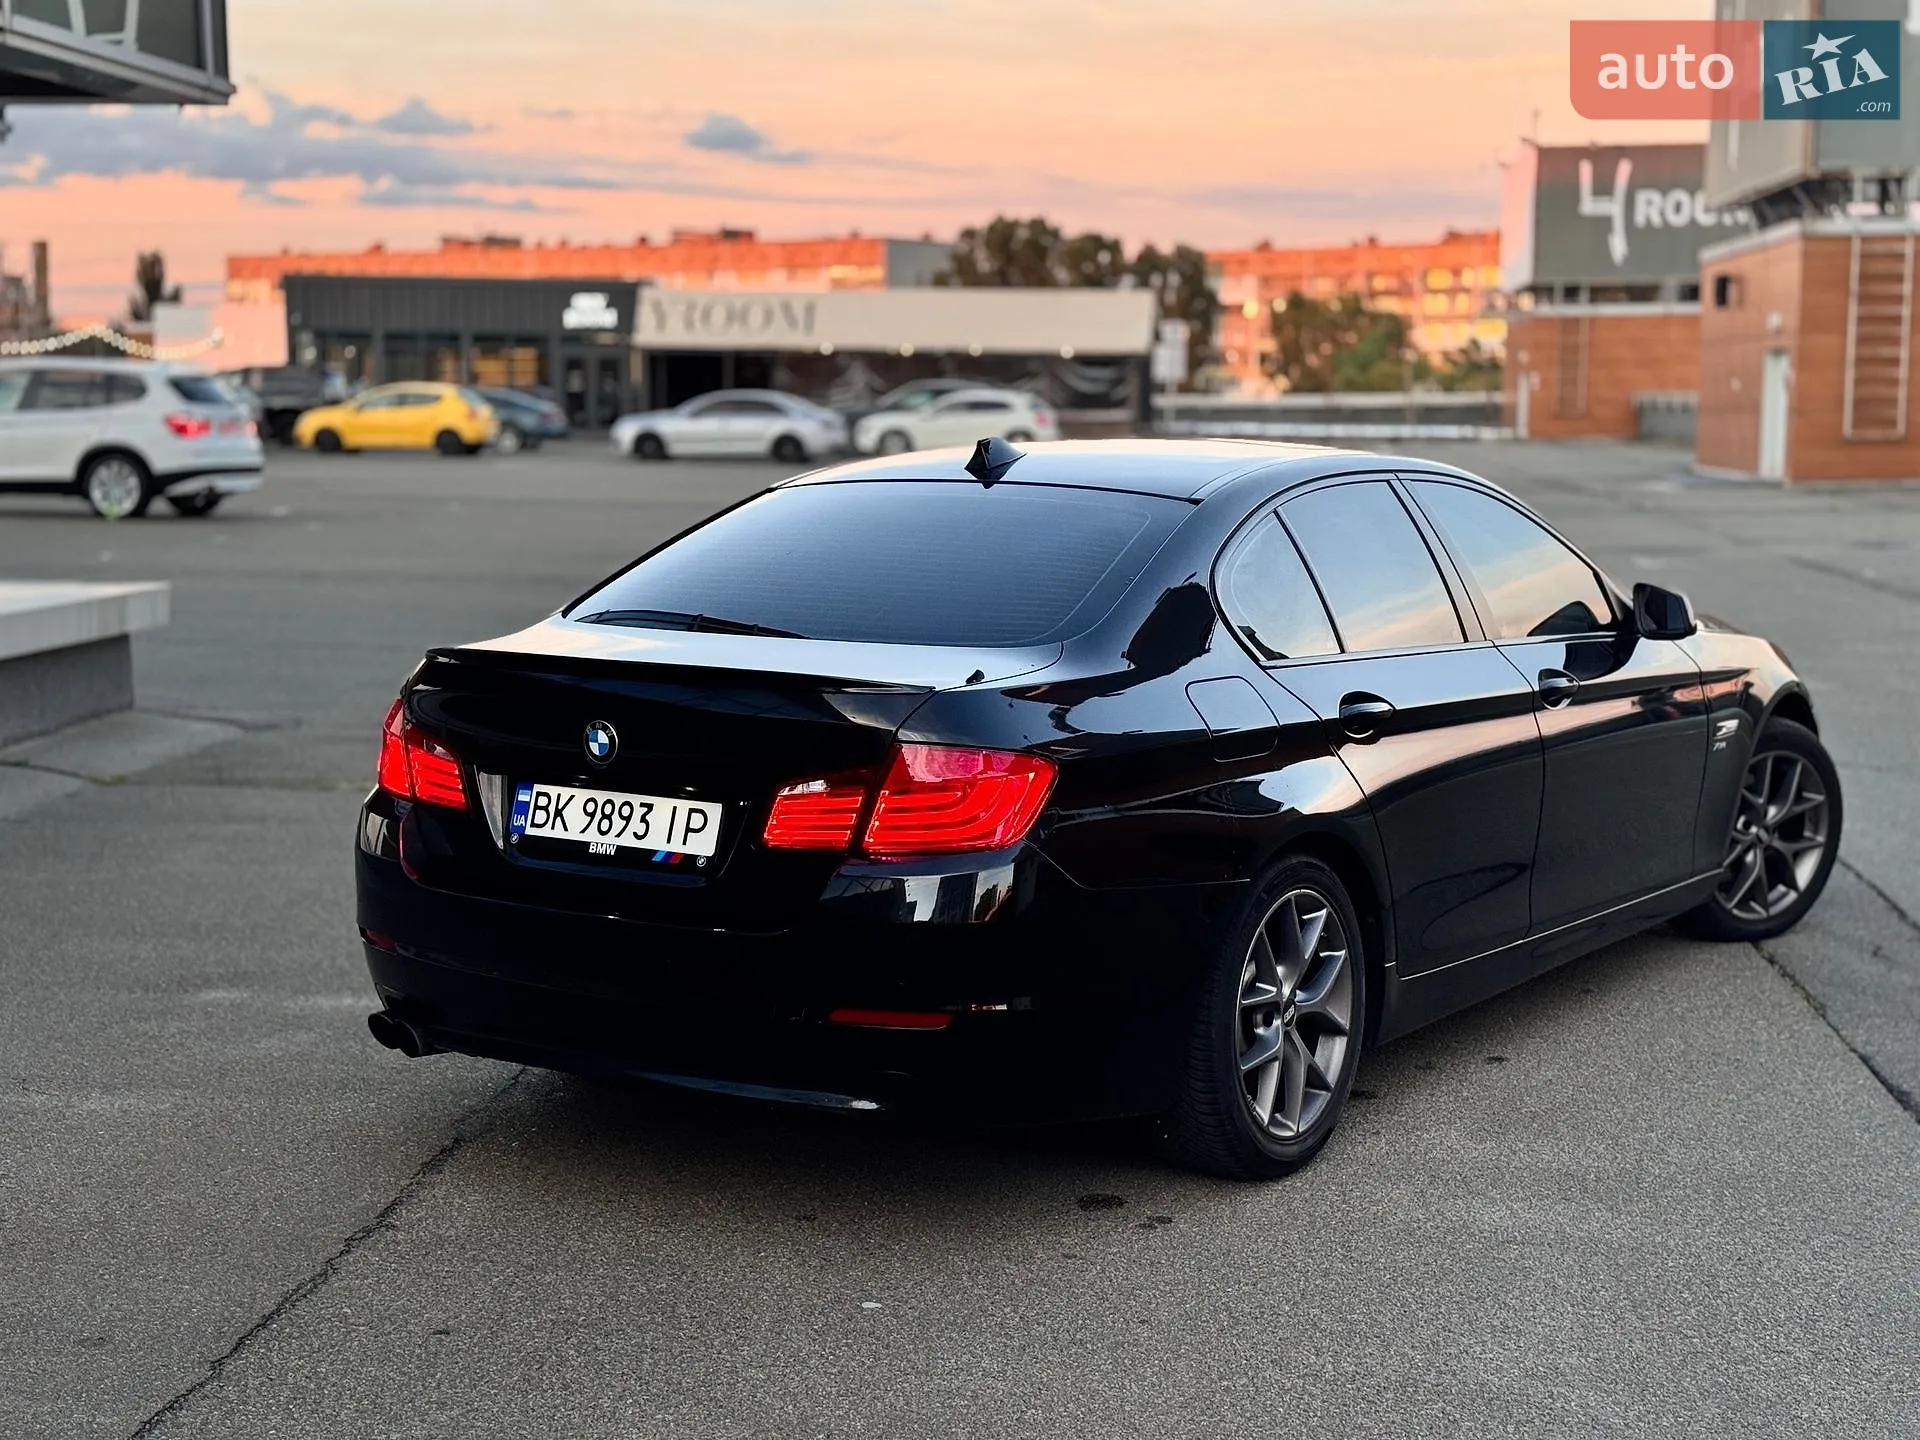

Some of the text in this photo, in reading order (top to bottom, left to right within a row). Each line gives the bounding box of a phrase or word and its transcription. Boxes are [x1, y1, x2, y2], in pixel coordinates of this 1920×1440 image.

[513, 814, 526, 827] UA
[529, 790, 576, 832] BK
[578, 796, 655, 841] 9893
[588, 842, 617, 856] BMW
